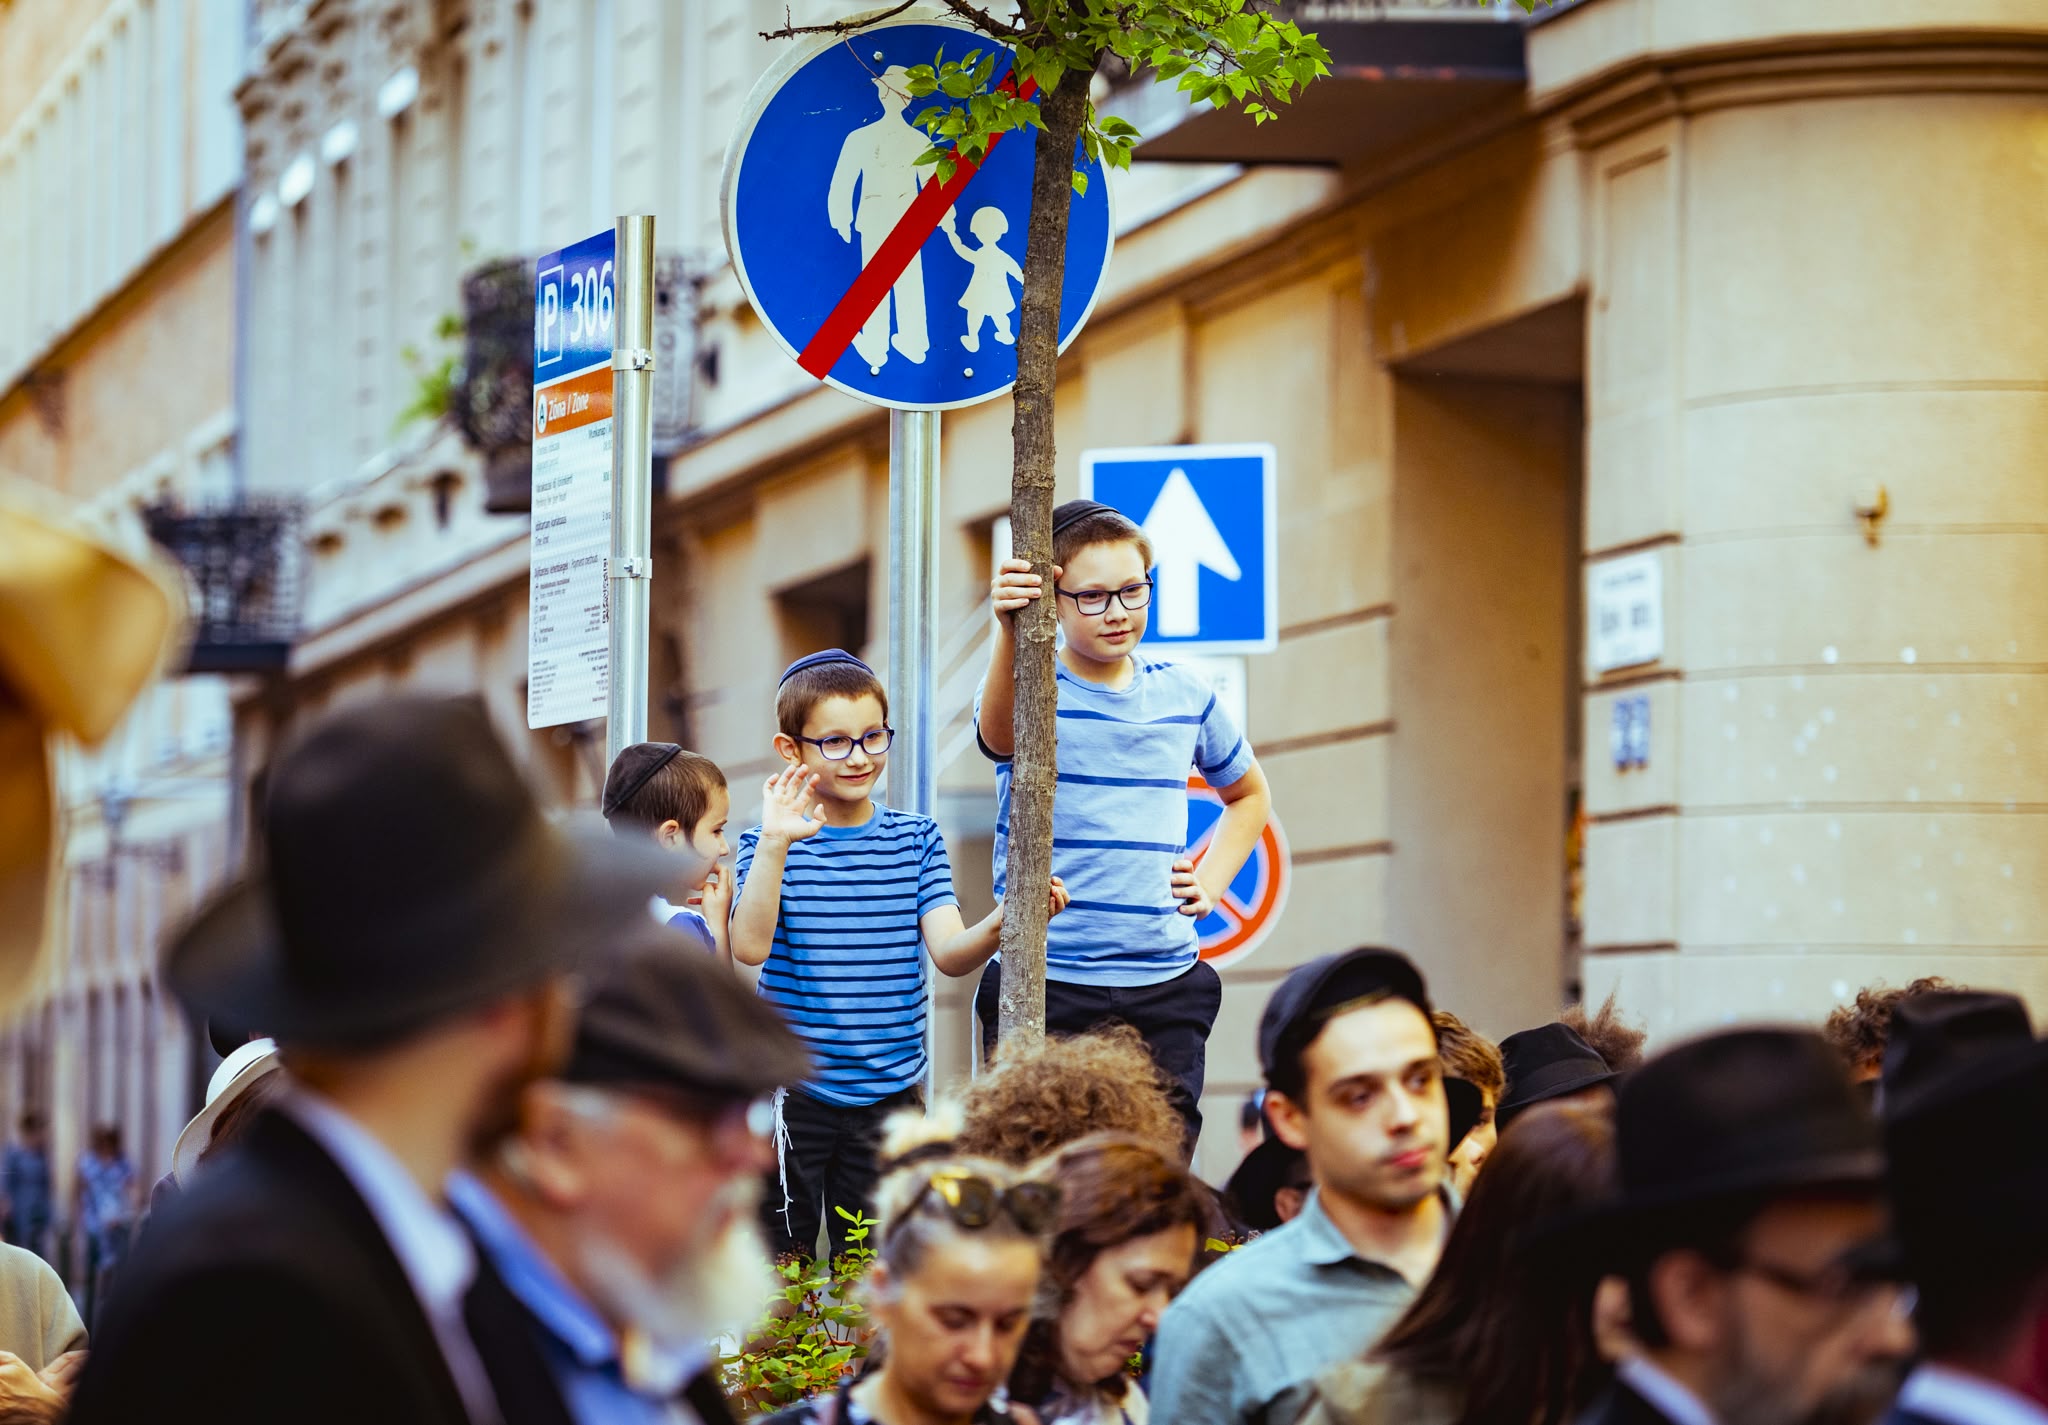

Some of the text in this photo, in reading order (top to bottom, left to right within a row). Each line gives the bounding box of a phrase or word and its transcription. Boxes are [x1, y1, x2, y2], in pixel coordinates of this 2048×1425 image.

[544, 260, 615, 352] P 306
[571, 391, 590, 414] Zone
